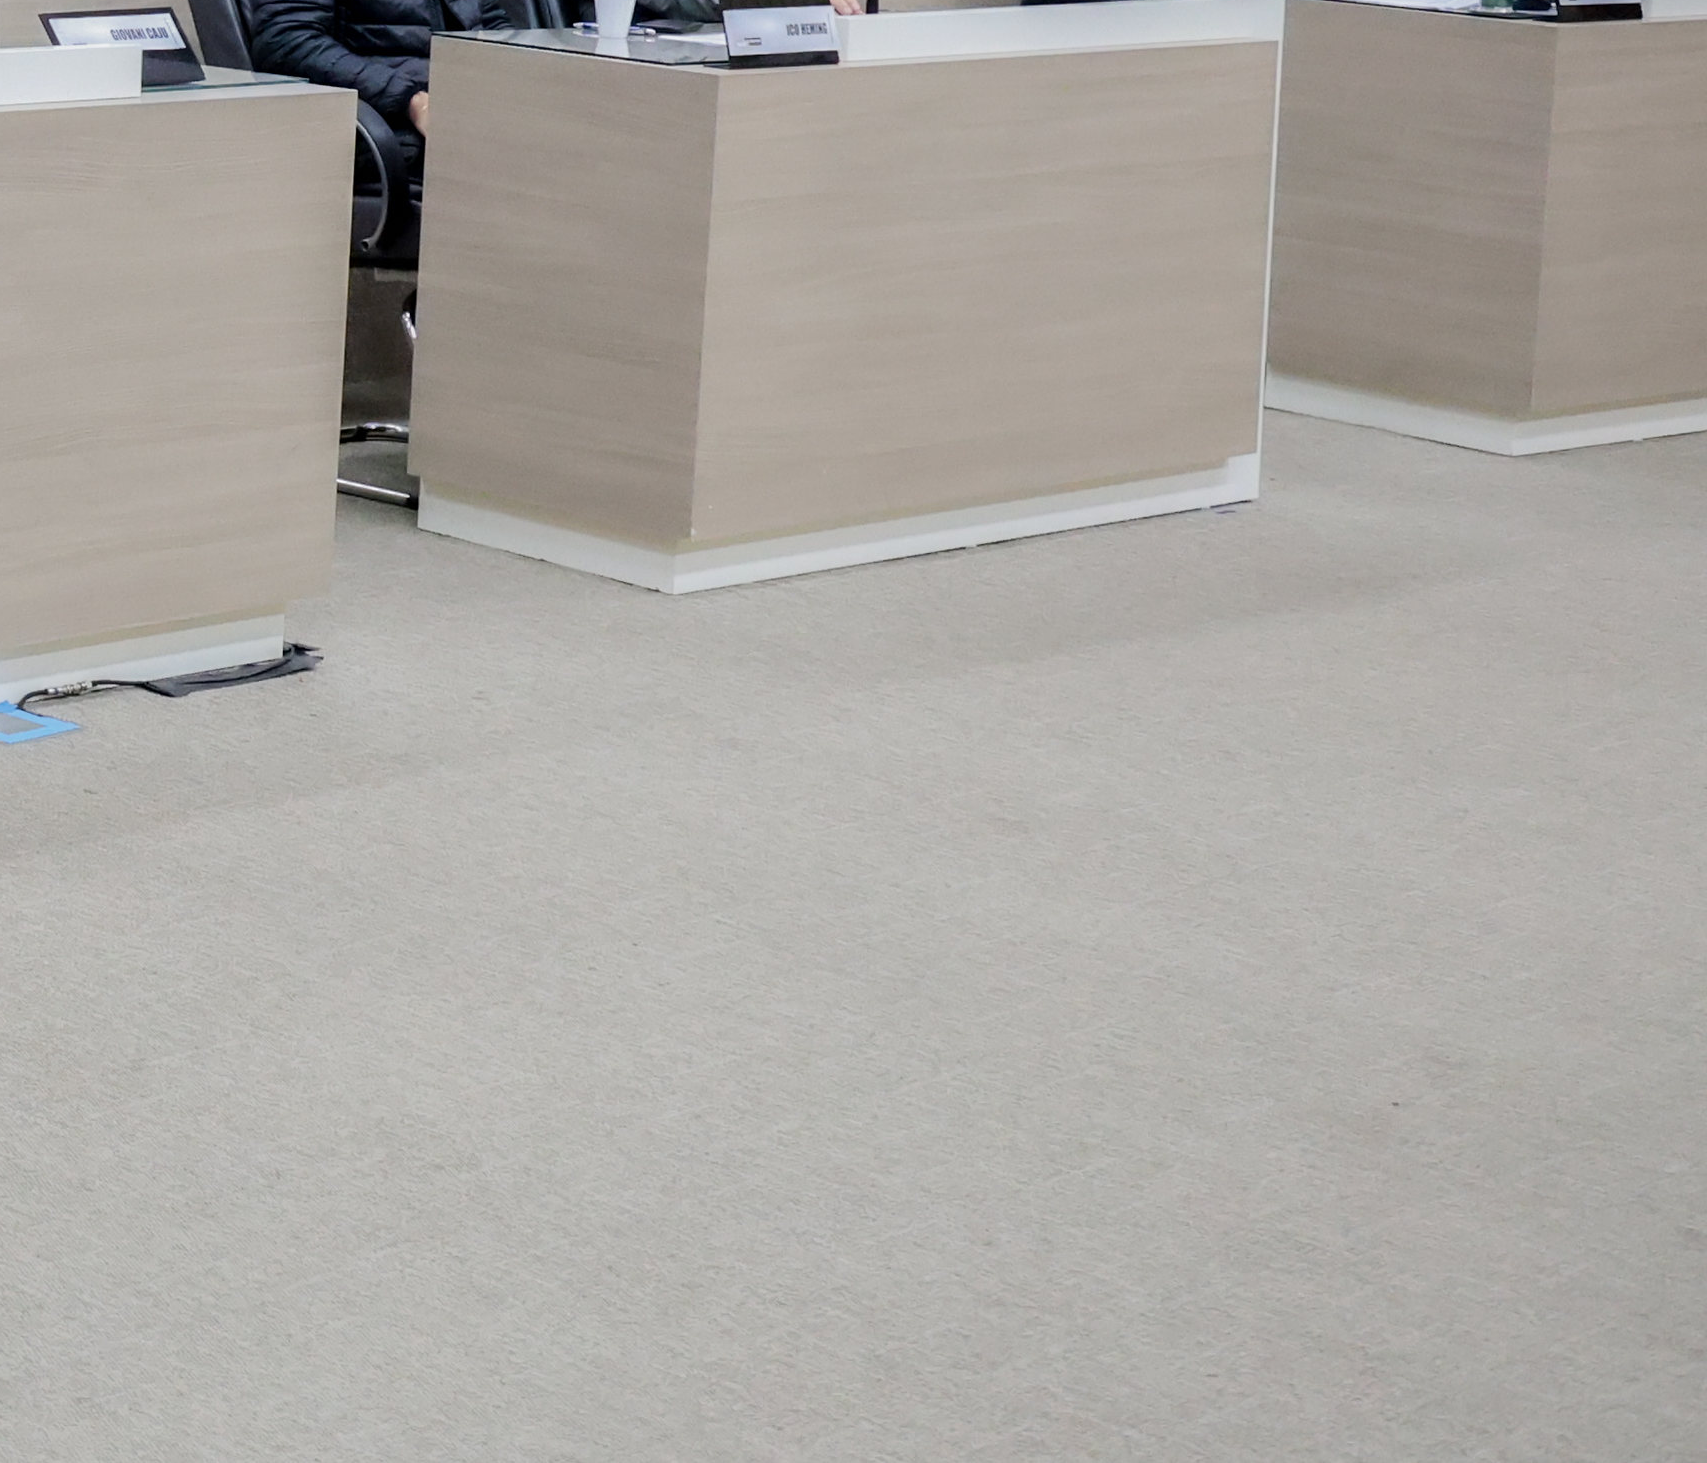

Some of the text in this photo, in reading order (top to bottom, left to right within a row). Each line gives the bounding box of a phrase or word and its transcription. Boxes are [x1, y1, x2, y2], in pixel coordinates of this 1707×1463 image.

[110, 26, 169, 41] GIOVANI CAJU
[786, 24, 800, 36] ICO
